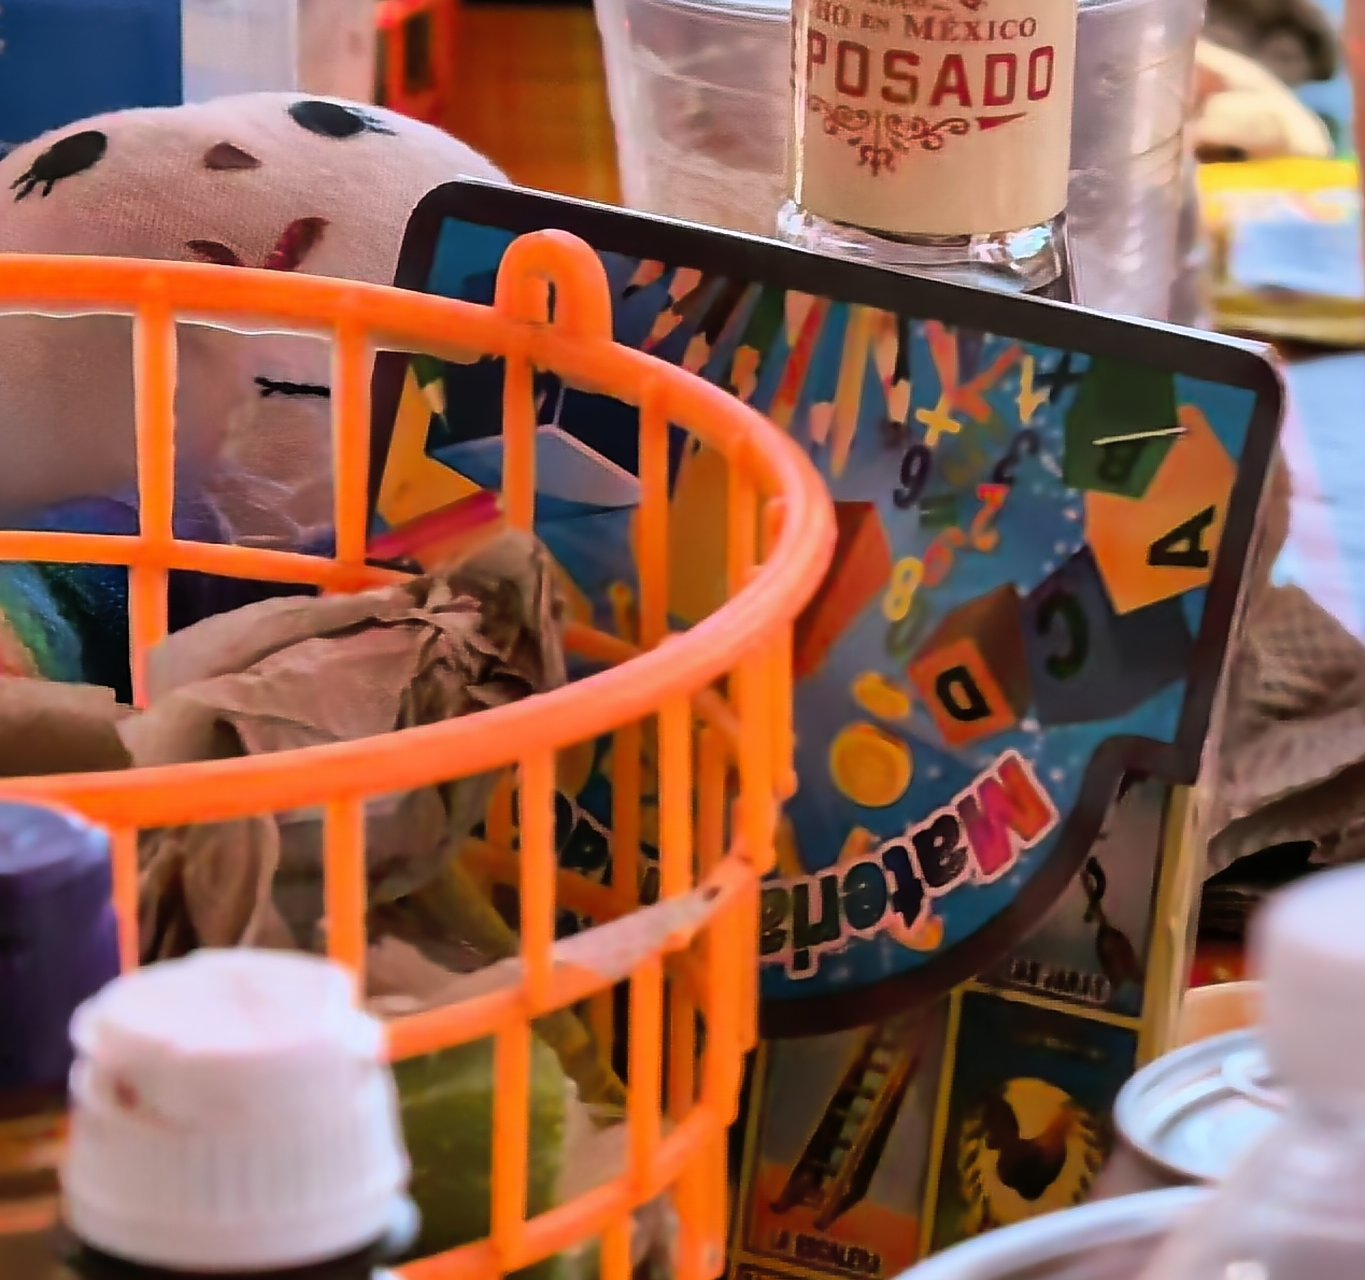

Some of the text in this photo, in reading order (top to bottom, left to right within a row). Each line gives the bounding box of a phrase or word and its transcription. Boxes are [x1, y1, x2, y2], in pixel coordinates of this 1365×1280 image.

[1148, 505, 1216, 567] A
[1036, 590, 1089, 681] C
[936, 665, 991, 721] D
[759, 753, 1055, 974] Materia
